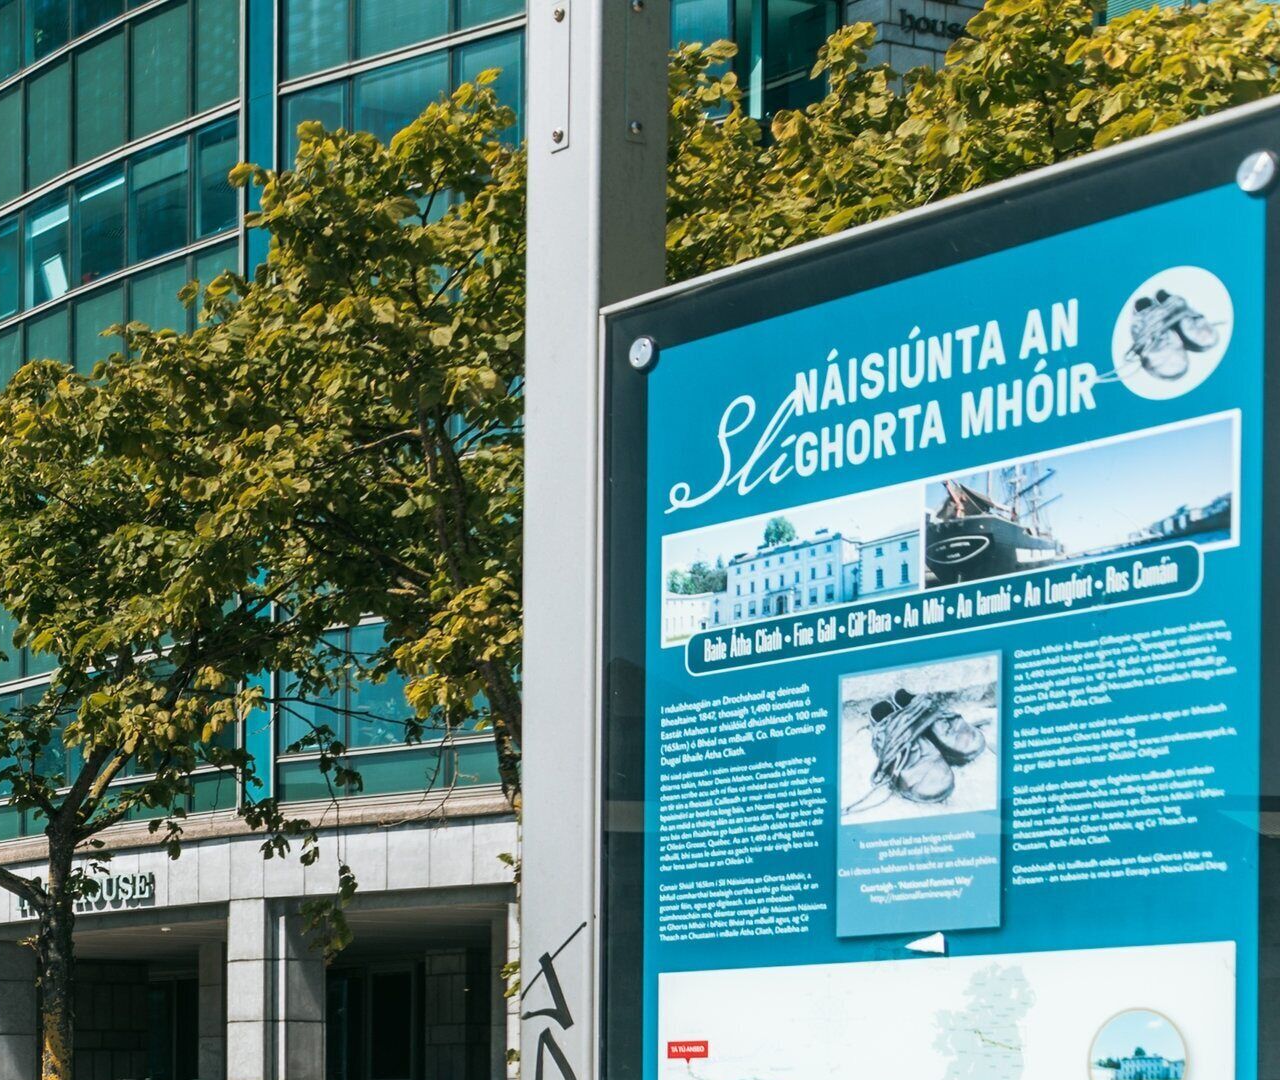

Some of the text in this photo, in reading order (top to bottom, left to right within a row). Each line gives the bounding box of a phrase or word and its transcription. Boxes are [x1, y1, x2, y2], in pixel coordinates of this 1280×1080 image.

[795, 298, 1079, 416] NÁISIÚNTA AN
[664, 359, 1097, 514] Slí GHORTA MHÓIR
[704, 638, 726, 662] Baile
[730, 628, 751, 658] Átha
[755, 626, 782, 654] Cliath
[794, 623, 814, 648] Fine
[817, 617, 836, 643] Gall
[868, 609, 891, 635] Dara
[904, 603, 918, 628] An
[922, 596, 946, 625] Mhí
[956, 593, 972, 620] An
[976, 584, 1012, 616] Iarmhí
[1024, 581, 1041, 608] An
[1045, 573, 1092, 607] Longfort
[1106, 566, 1129, 594] Ros
[1133, 556, 1178, 590] Comáin
[74, 873, 153, 904] OUSE
